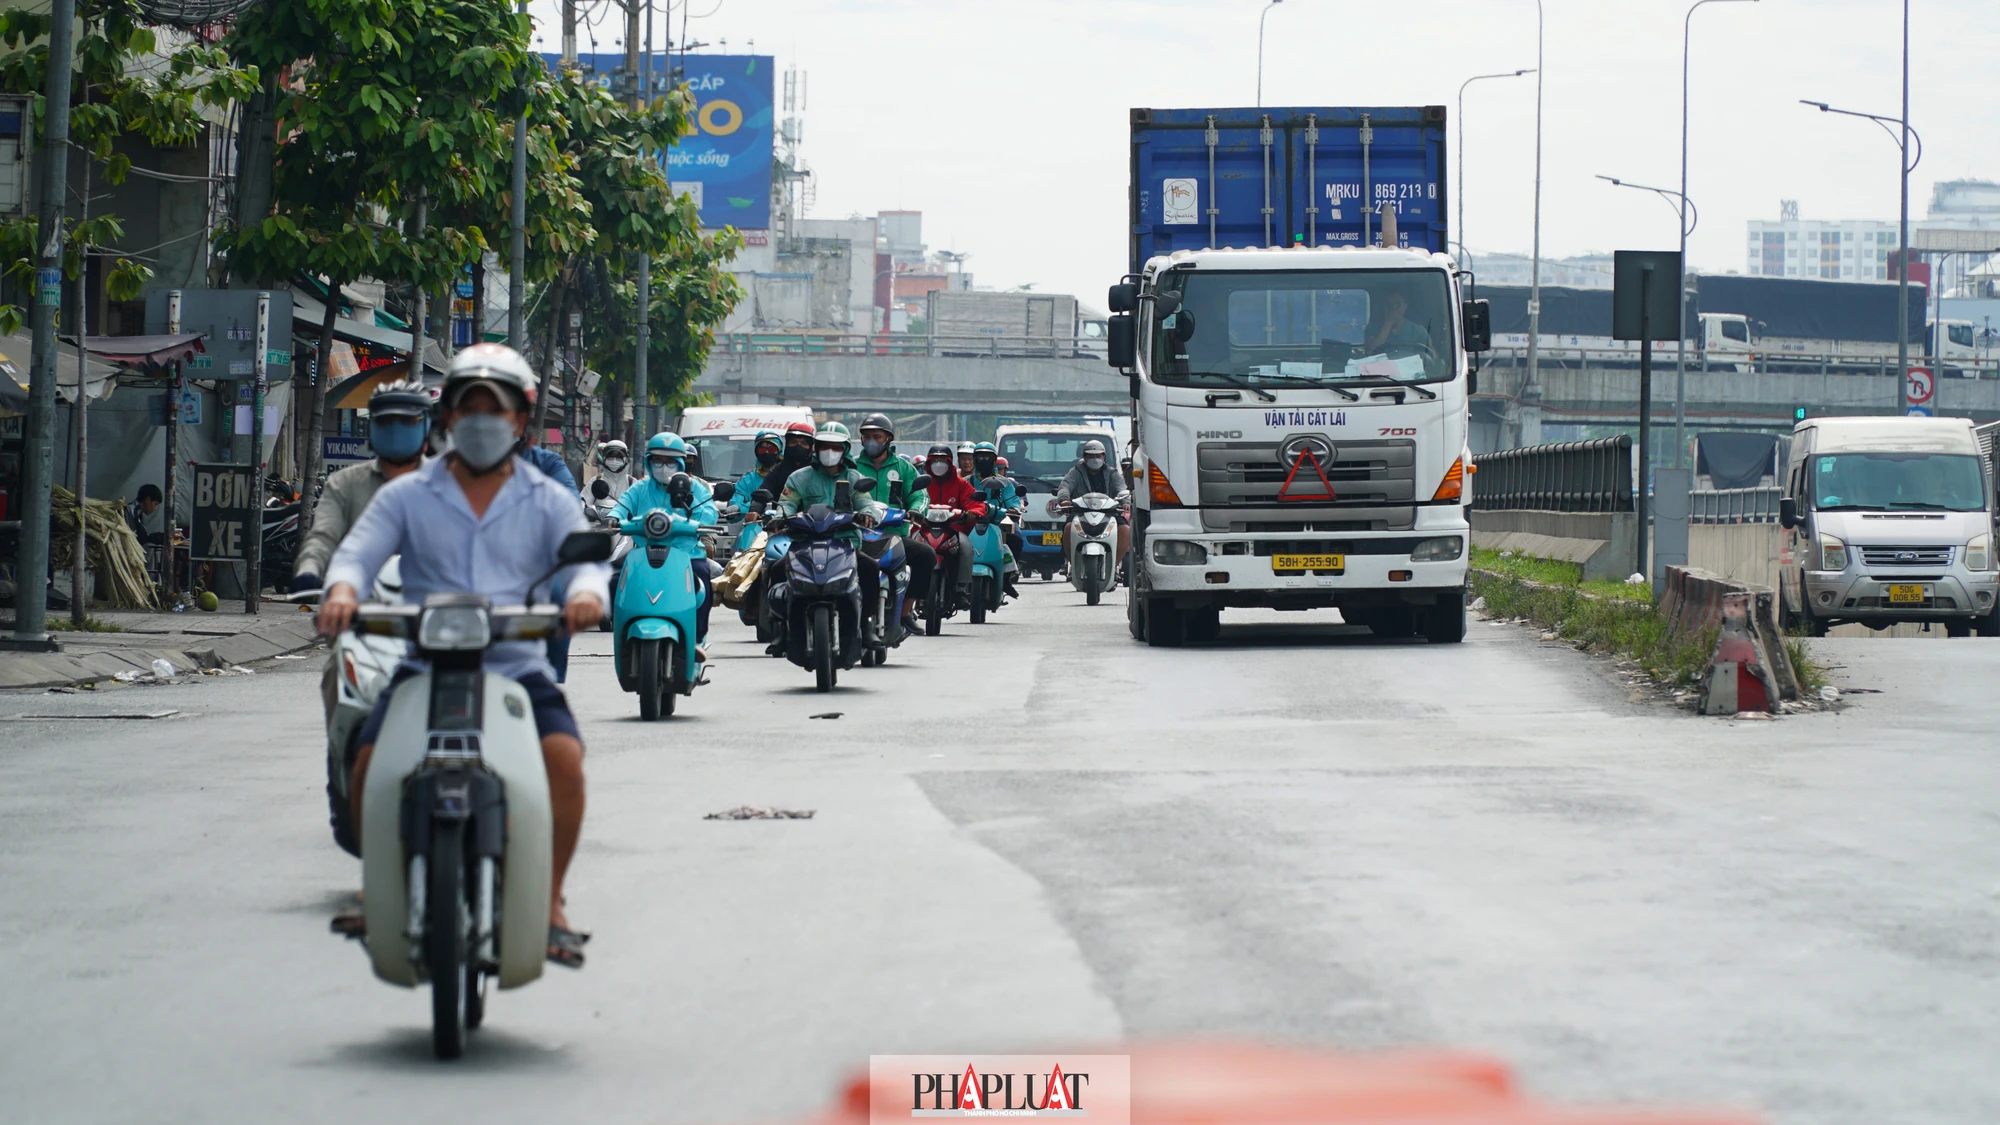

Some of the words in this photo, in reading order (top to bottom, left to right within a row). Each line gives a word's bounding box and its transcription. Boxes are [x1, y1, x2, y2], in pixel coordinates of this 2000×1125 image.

[696, 148, 730, 168] sống
[1325, 183, 1360, 198] MRKU
[1375, 183, 1397, 198] 869
[1400, 183, 1422, 198] 213
[1400, 232, 1409, 240] KG
[1264, 409, 1286, 429] VẬN
[1288, 407, 1305, 426] TẢI
[1308, 408, 1327, 426] CÁT
[1330, 408, 1346, 426] LÁI
[700, 419, 726, 431] Lê
[1377, 427, 1417, 436] 700
[1196, 430, 1243, 439] HINO
[326, 442, 358, 455] YIKANG
[208, 520, 243, 556] XE
